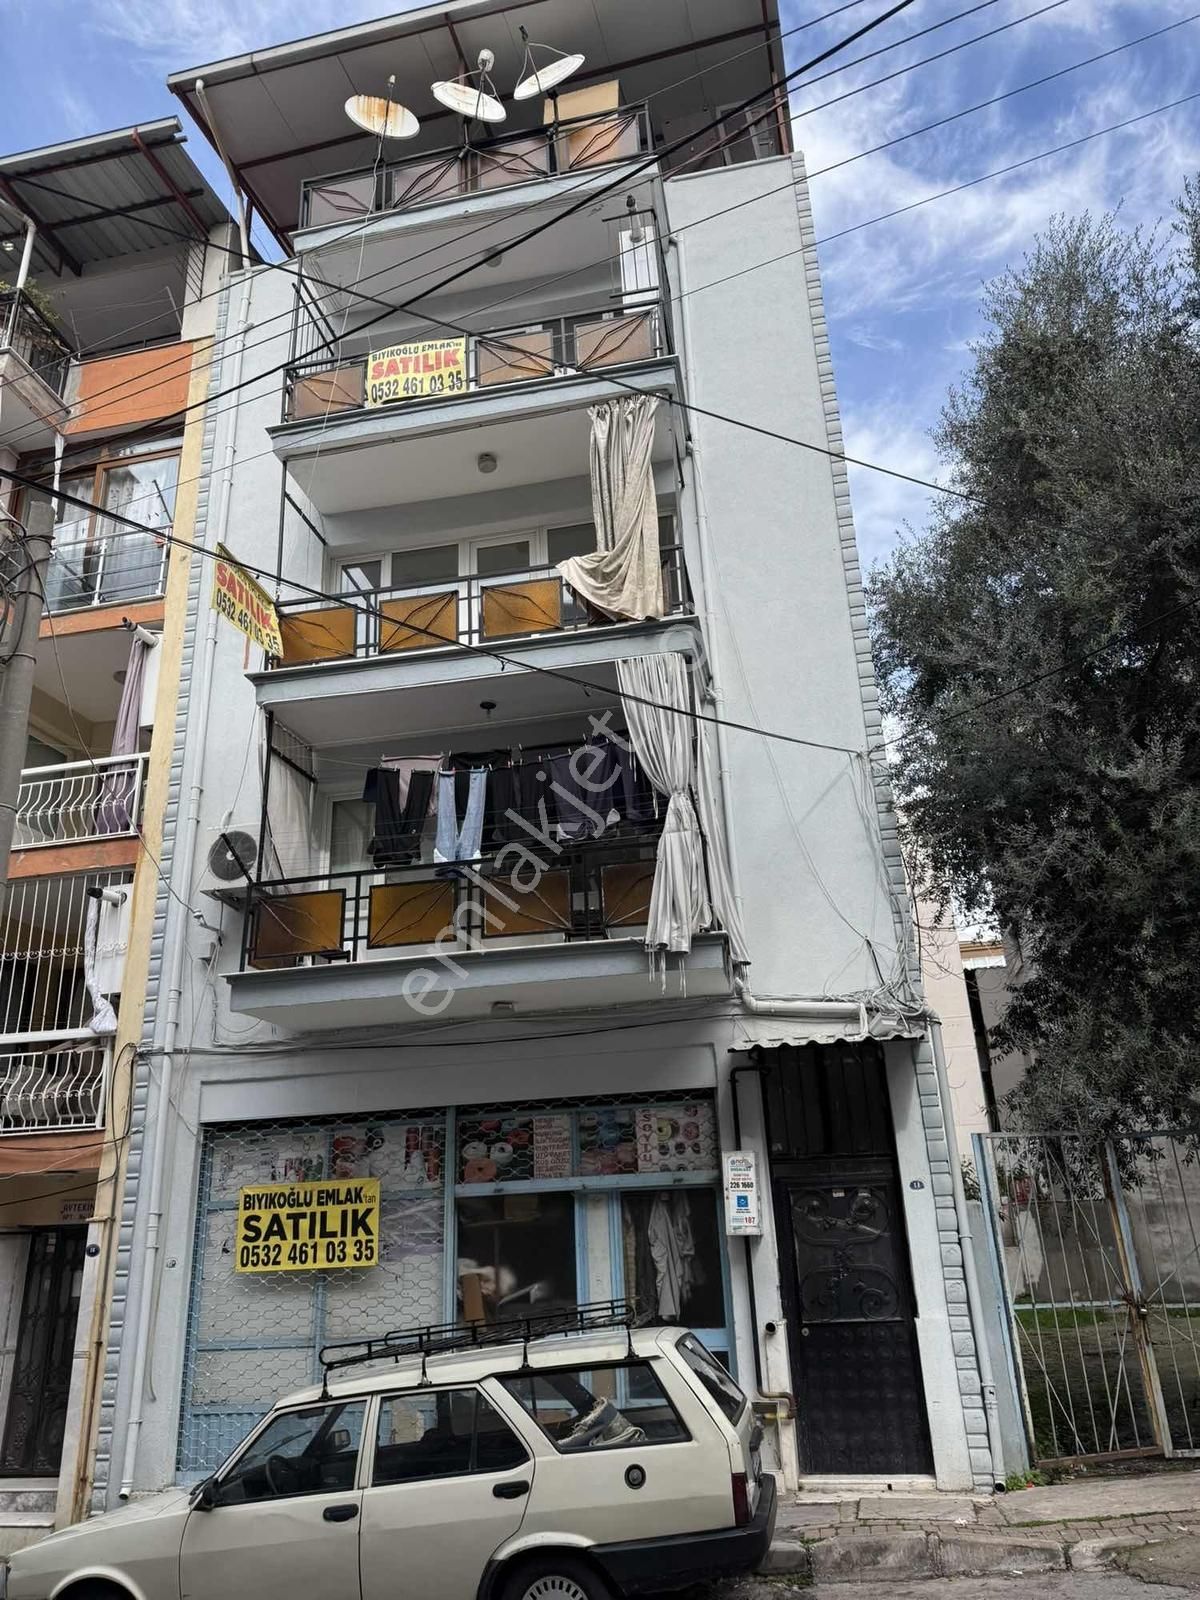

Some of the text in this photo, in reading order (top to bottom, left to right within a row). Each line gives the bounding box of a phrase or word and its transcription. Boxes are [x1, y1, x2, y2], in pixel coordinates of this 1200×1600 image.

[371, 348, 461, 380] SATILIK
[371, 370, 463, 403] 0532 461 03 35
[216, 562, 276, 632] SATILIK
[216, 588, 236, 621] 0532
[266, 633, 280, 653] 35
[243, 1187, 313, 1211] BIYIKOĞLU
[730, 1181, 740, 1189] 226
[242, 1207, 375, 1243] SATILIK
[240, 1238, 374, 1268] 0532 461 03 35
